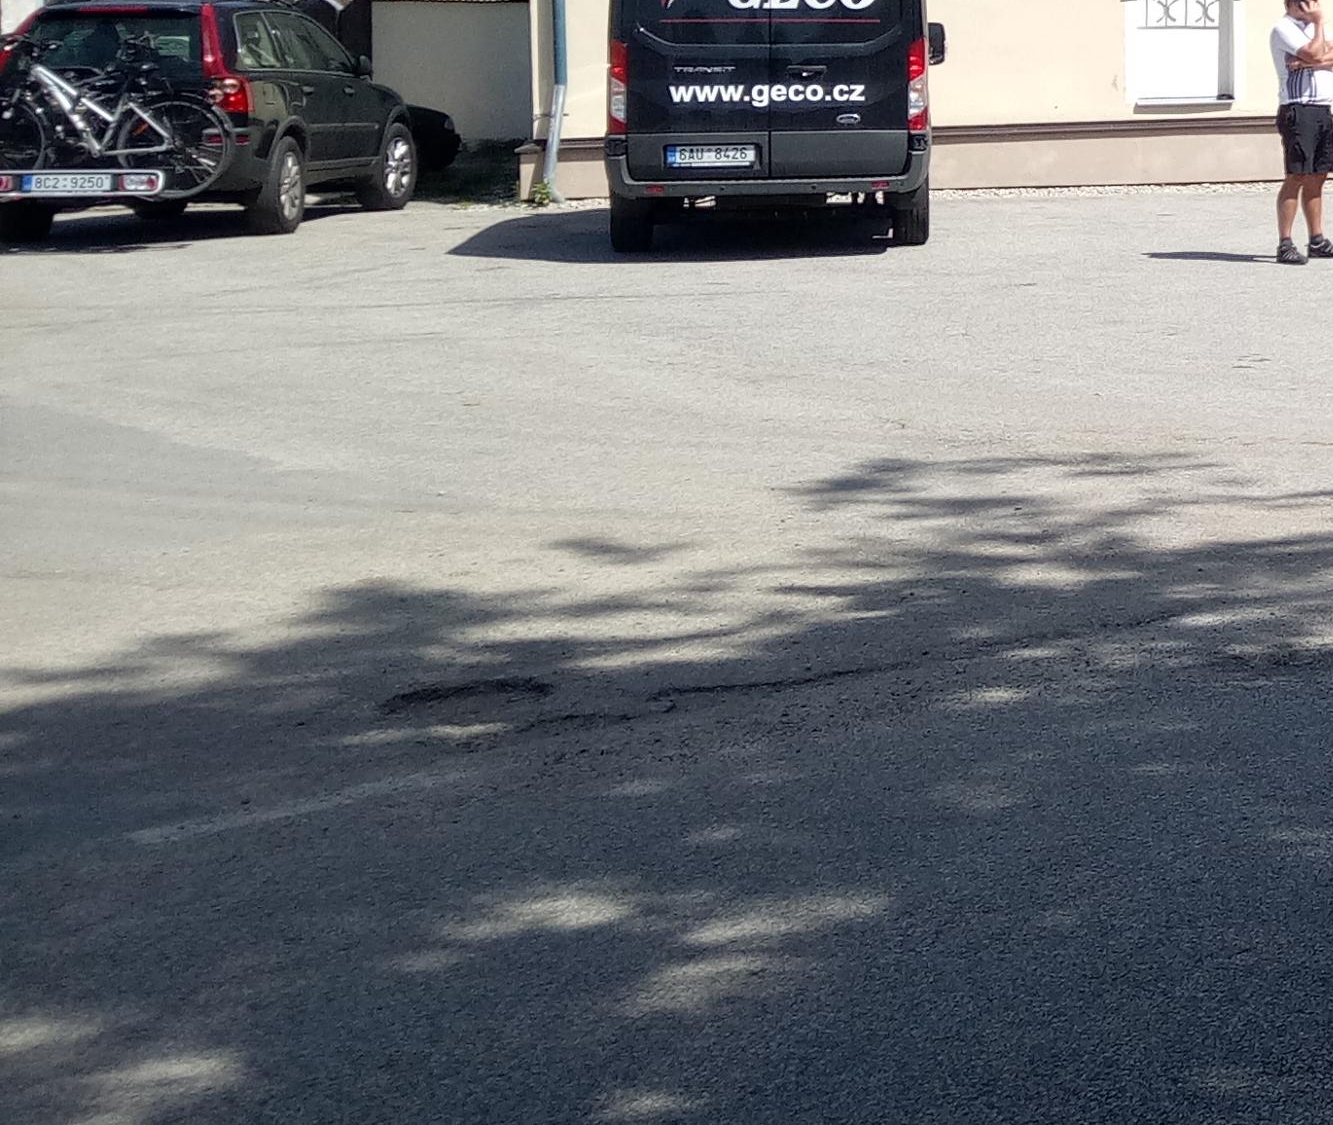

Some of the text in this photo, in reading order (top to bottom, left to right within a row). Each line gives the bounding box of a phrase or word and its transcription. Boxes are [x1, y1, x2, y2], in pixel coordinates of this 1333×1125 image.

[669, 84, 866, 107] www.geco.cz
[715, 147, 748, 161] 8426
[70, 176, 104, 189] 9250
